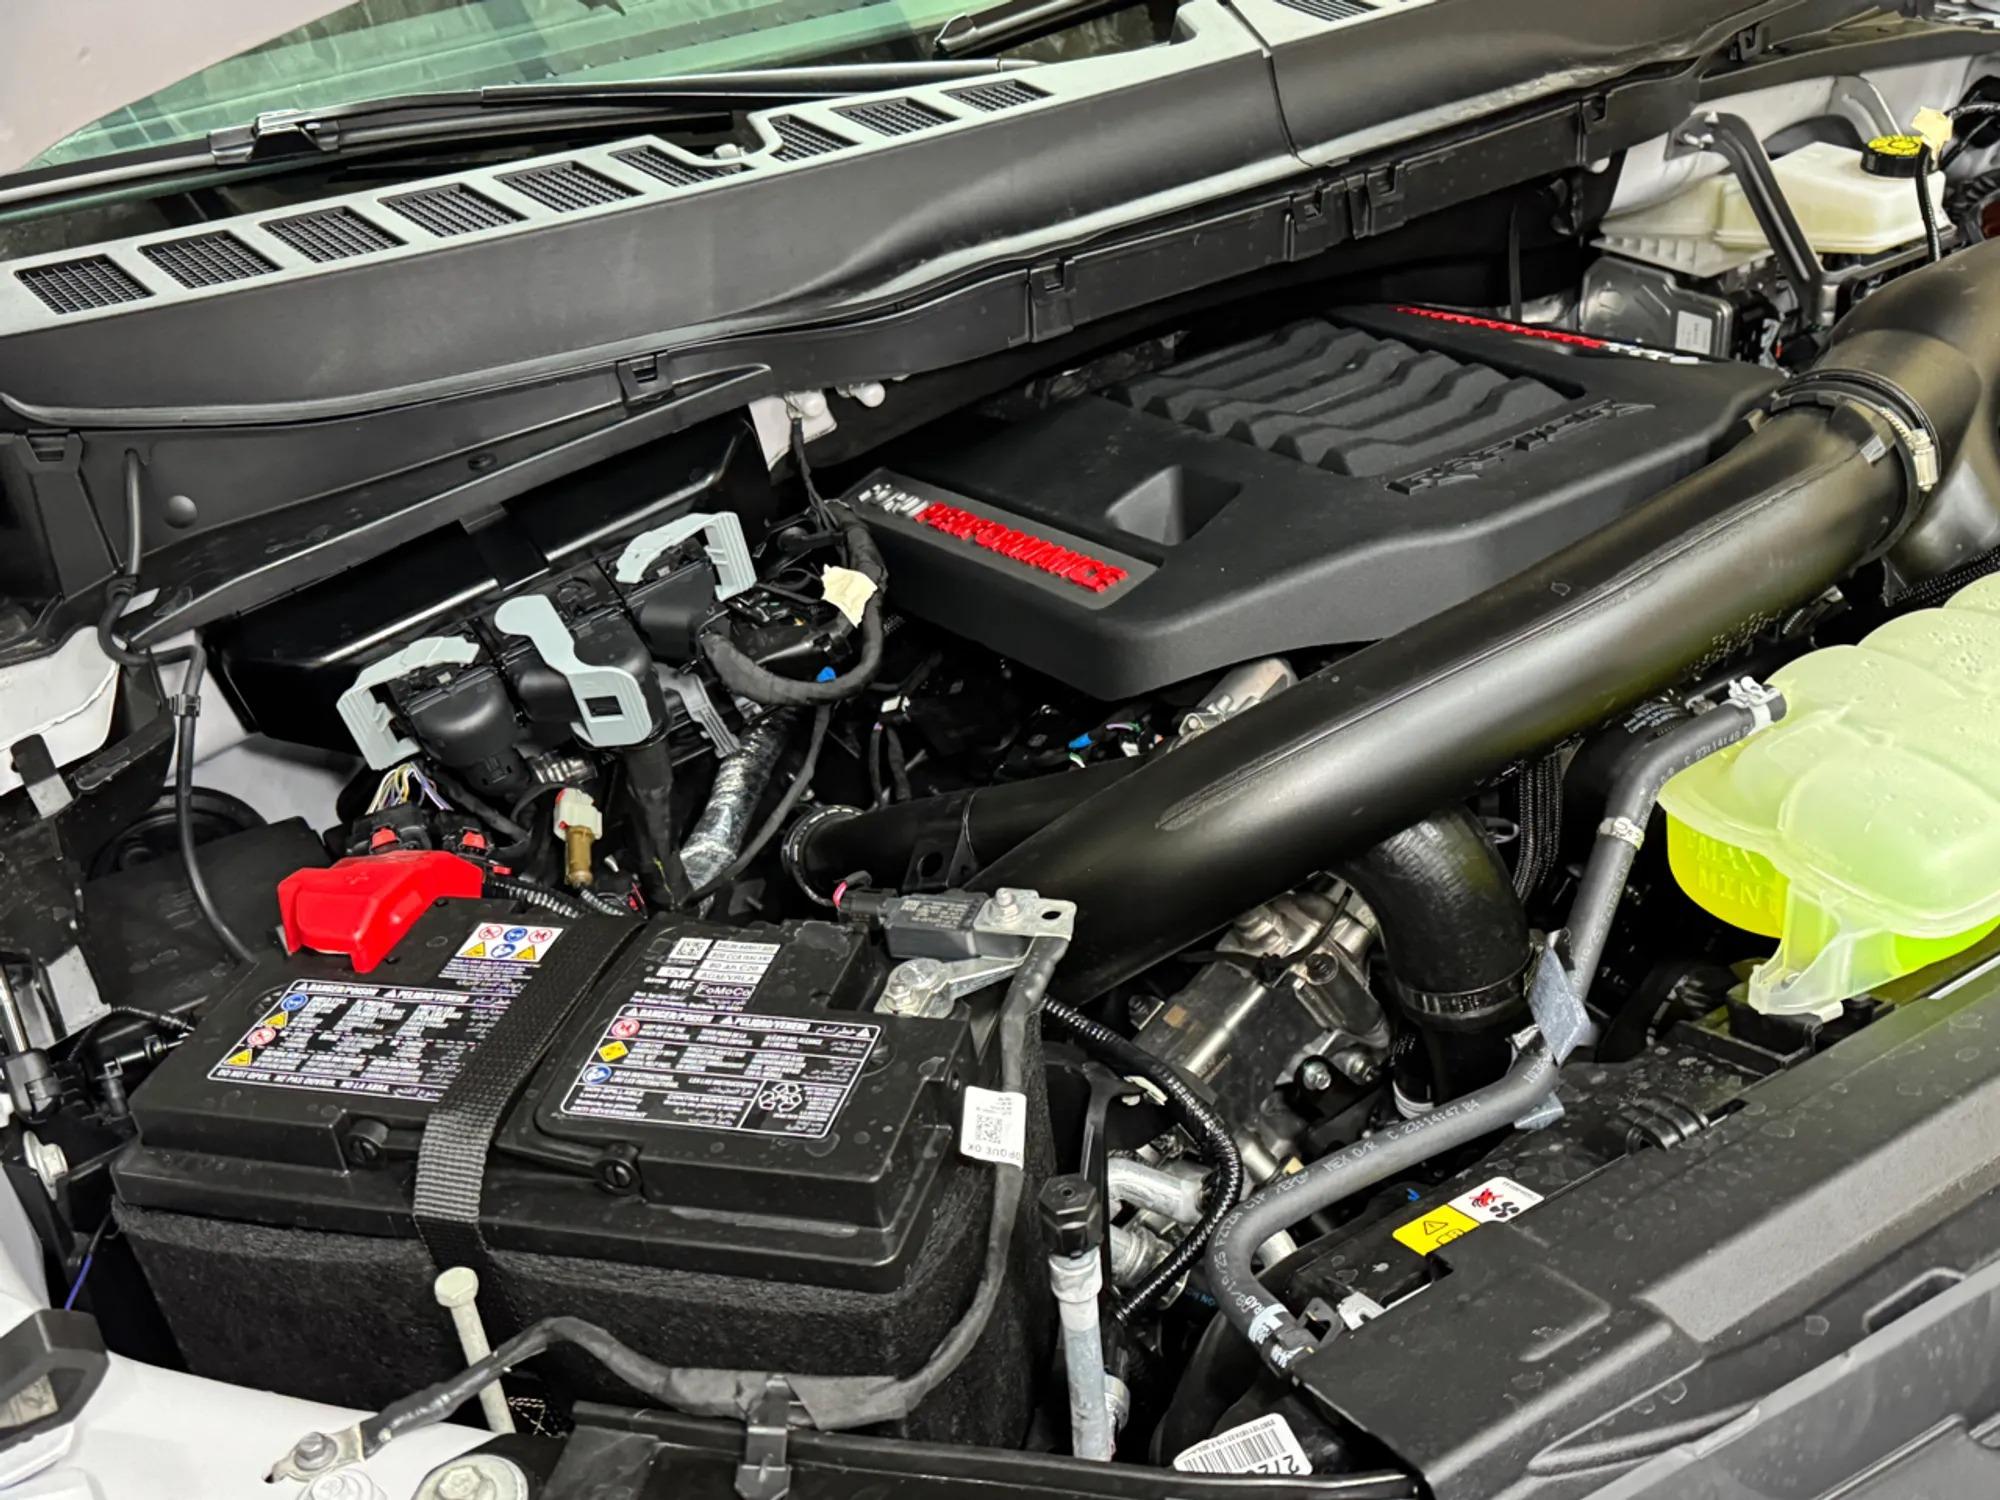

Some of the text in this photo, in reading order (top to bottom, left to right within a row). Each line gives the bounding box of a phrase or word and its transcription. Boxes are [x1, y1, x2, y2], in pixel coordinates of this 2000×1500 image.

[1698, 869, 1760, 909] MIN
[669, 980, 695, 989] MF
[698, 985, 750, 996] FoMoCo
[639, 1009, 713, 1024] DANGER/POISON
[734, 1016, 811, 1032] PELIGRO/VENENO
[228, 1070, 248, 1078] NOT
[285, 1075, 304, 1083] PAS
[339, 1080, 354, 1088] NO
[1322, 1154, 1350, 1172] MEX
[1245, 1294, 1265, 1315] RAD
